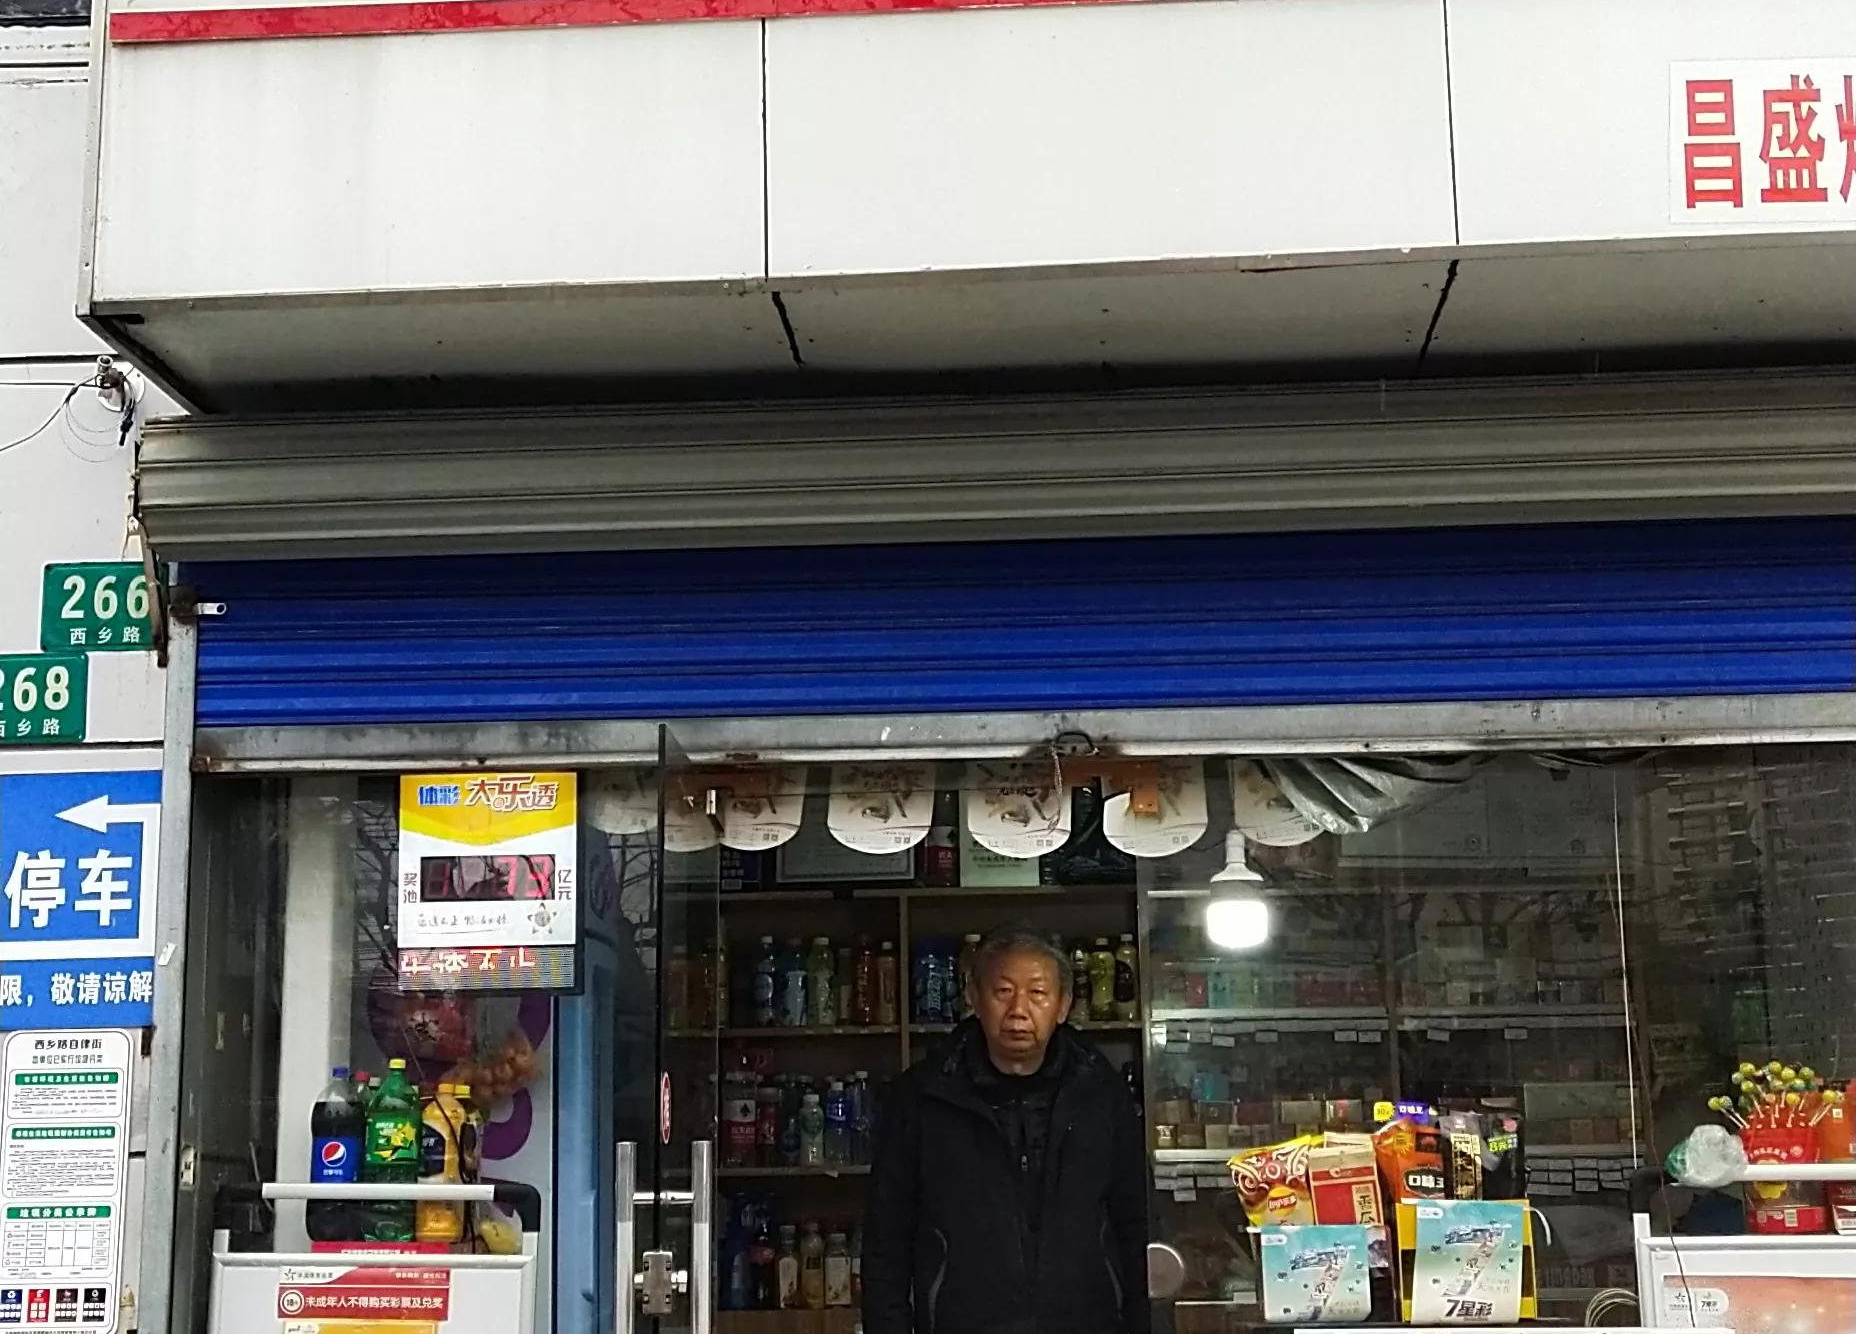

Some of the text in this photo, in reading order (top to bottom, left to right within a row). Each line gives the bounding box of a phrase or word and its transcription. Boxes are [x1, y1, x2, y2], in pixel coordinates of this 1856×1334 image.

[1684, 74, 1856, 209] 昌盛
[61, 575, 150, 619] 266
[70, 626, 140, 645] 西乡路
[0, 666, 69, 711] 68
[418, 775, 560, 811] 体彩 大乐透
[4, 849, 132, 928] 停车
[403, 872, 418, 904] 奖池
[557, 869, 572, 901] 亿元
[305, 1296, 443, 1309] 未成年人不得购买彩票及兑奖
[1446, 1299, 1493, 1317] 7星彩
